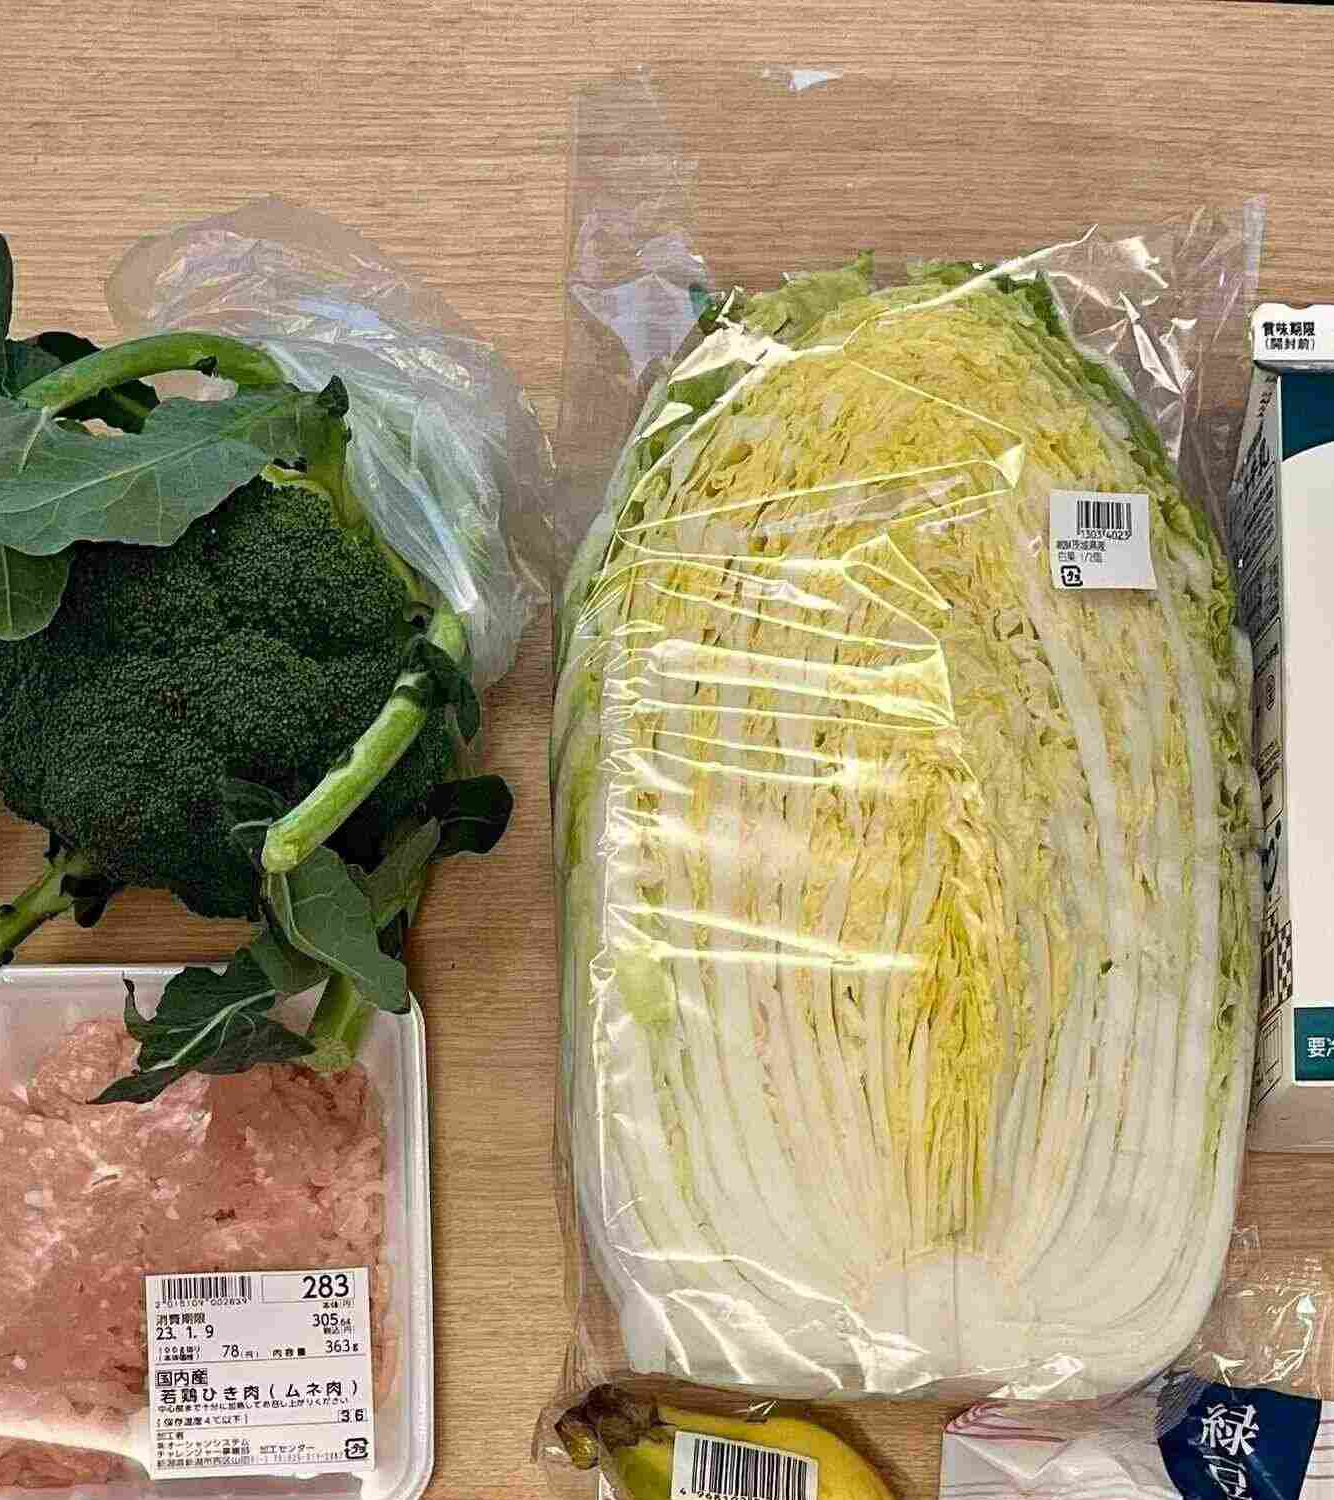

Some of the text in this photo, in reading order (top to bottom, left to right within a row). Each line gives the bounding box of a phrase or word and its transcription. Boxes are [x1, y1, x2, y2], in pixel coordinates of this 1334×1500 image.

[1262, 321, 1315, 337] 賞味期限
[1264, 337, 1315, 351] (開封前)
[302, 1274, 349, 1299] 283
[156, 1314, 205, 1326] 消費期限
[156, 1326, 214, 1340] 23.1.9
[325, 1340, 359, 1353] 363g
[157, 1369, 208, 1386] 国内産
